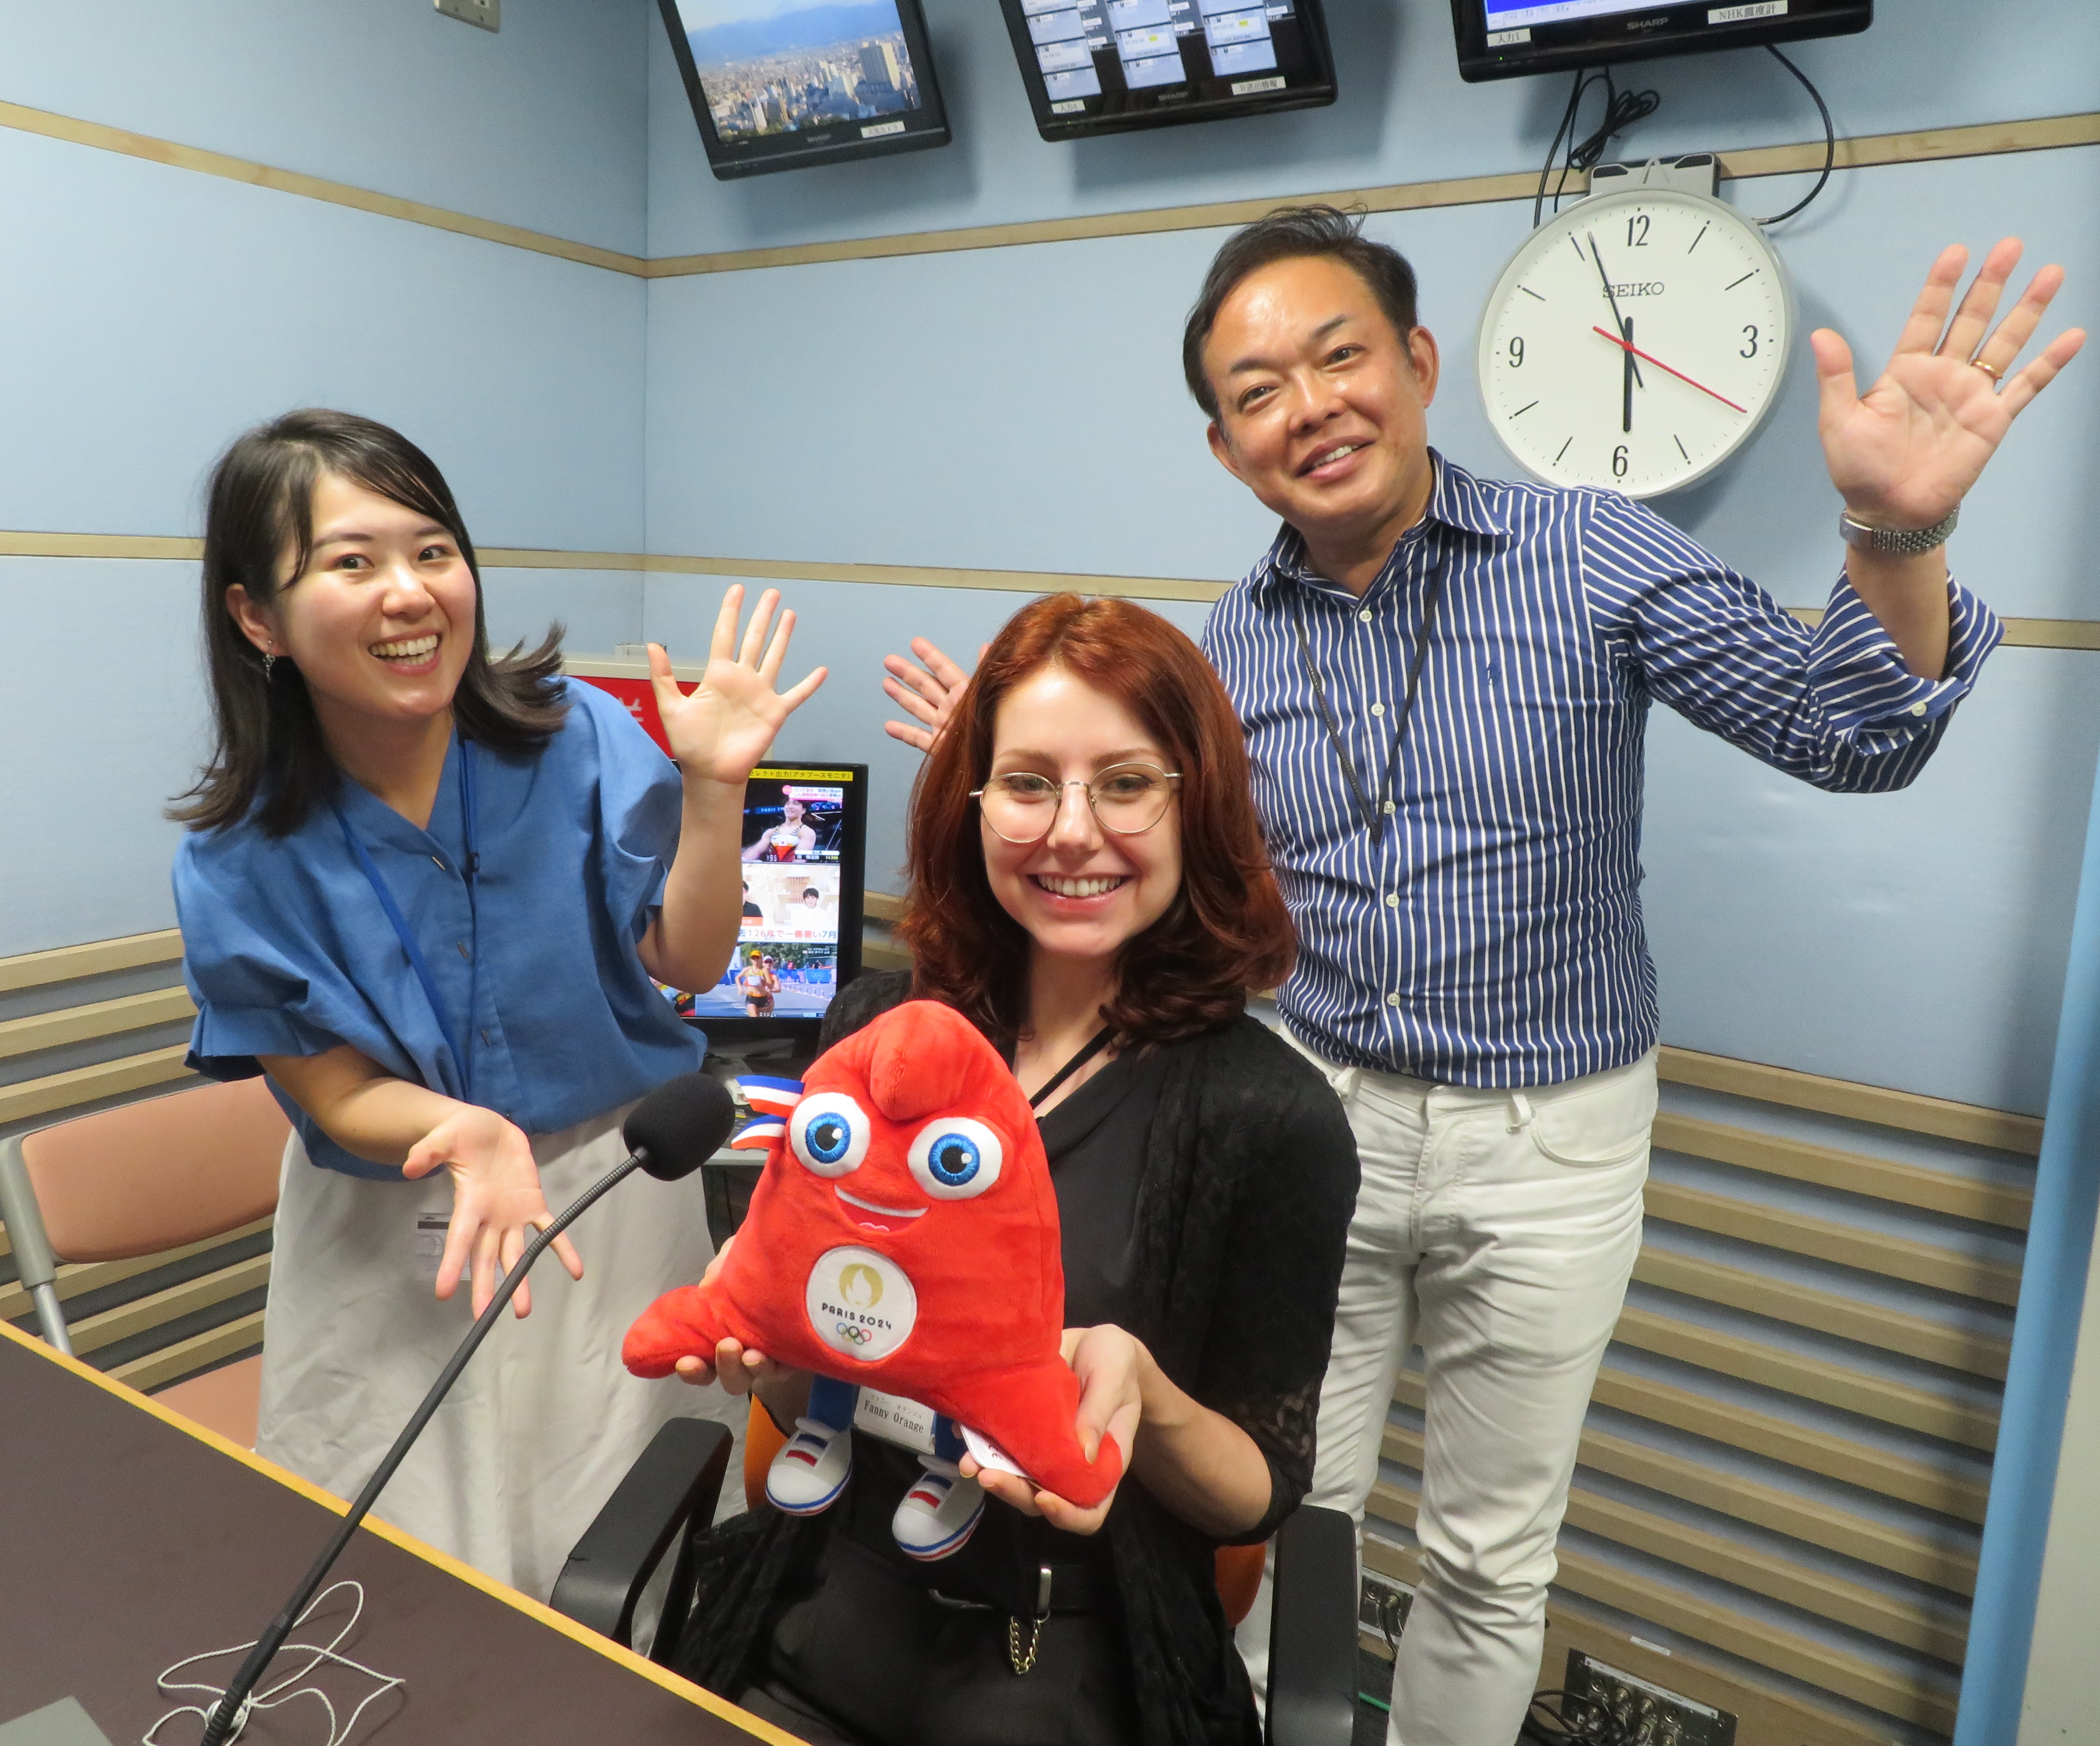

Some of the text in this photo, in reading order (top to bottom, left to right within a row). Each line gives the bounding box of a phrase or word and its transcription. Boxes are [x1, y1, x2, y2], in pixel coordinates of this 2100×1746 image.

[1627, 17, 1668, 30] SHARP
[1626, 215, 1650, 247] 12
[1603, 281, 1665, 299] SEIKO
[1509, 336, 1524, 368] 9
[1740, 325, 1758, 358] 3
[1612, 445, 1629, 477] 6
[822, 1302, 892, 1330] PARIS 2024
[864, 1399, 924, 1433] Fanny Orange
